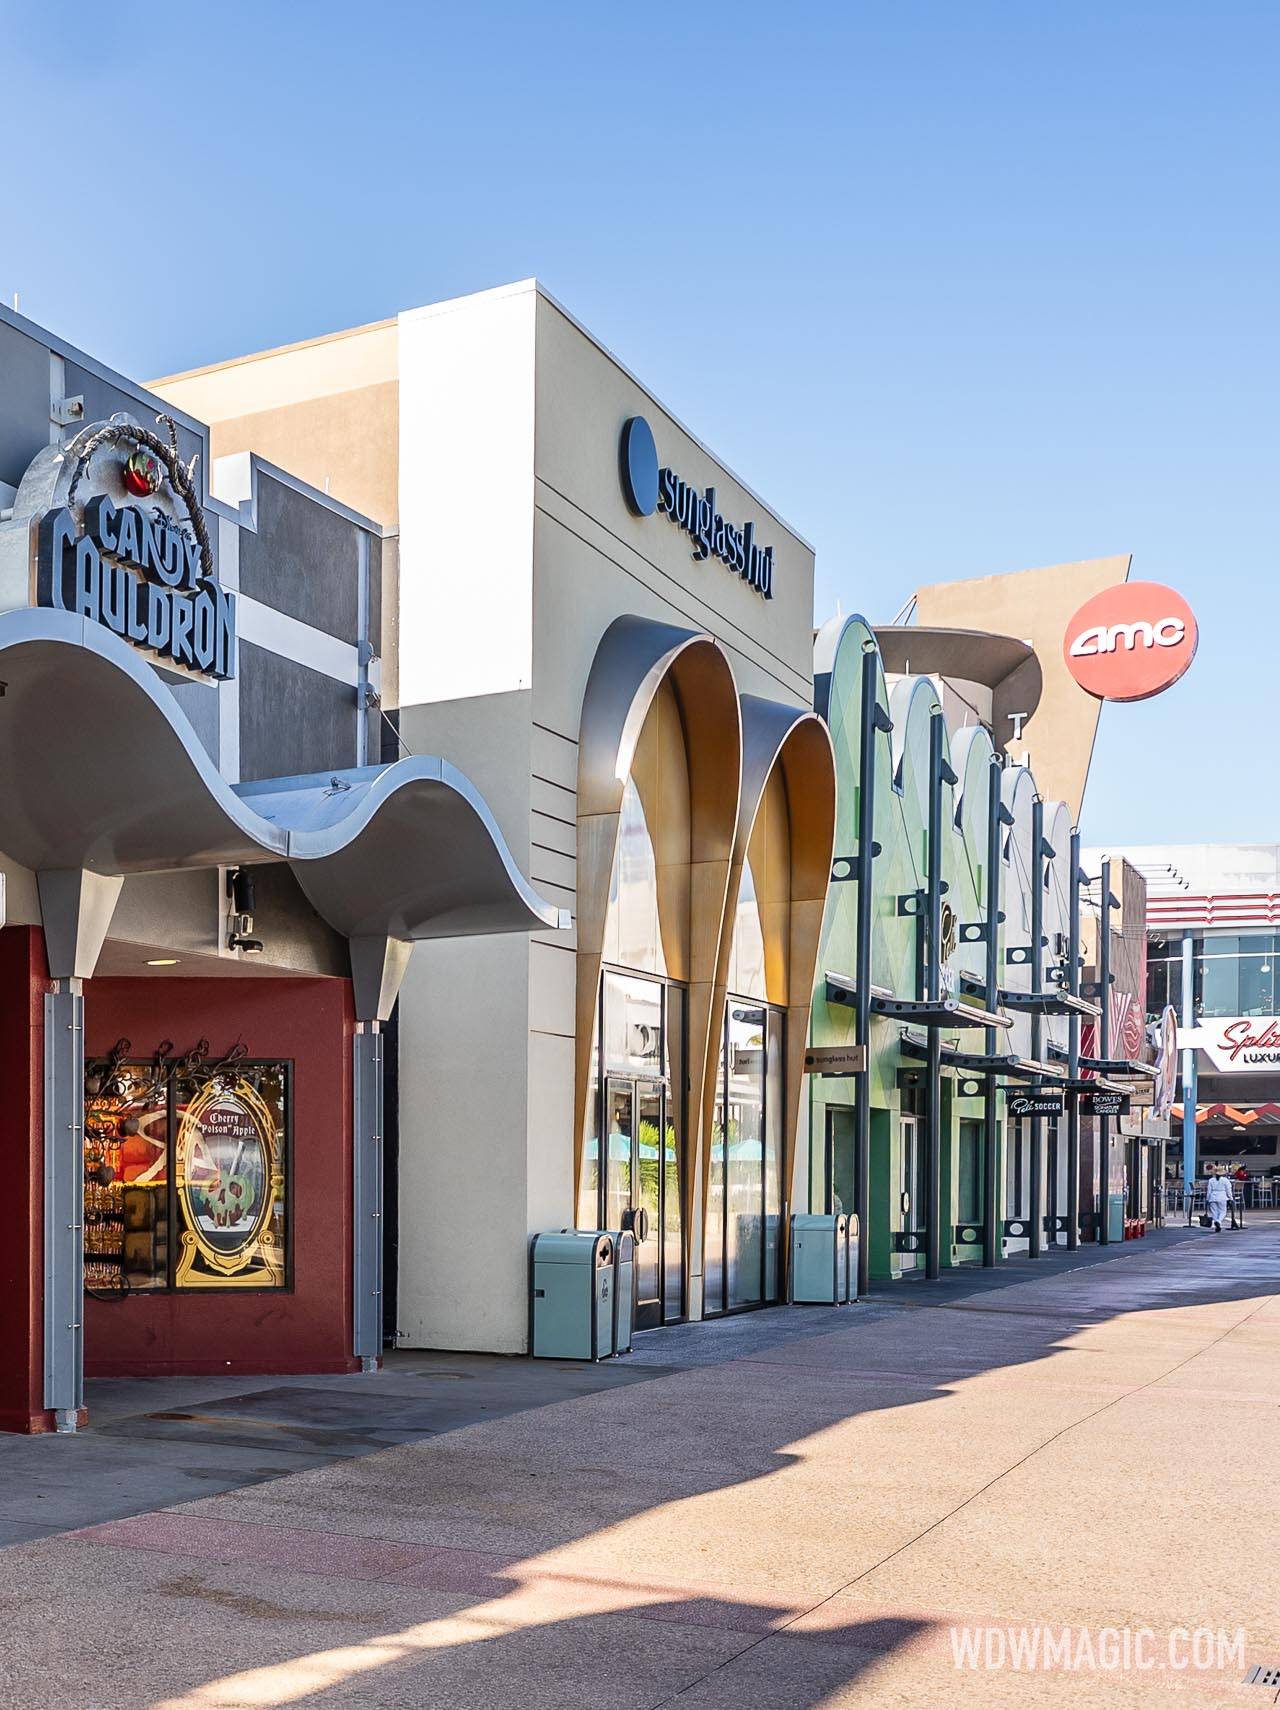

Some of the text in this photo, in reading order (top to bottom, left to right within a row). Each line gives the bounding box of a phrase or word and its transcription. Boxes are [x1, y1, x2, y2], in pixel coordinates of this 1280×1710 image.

[90, 496, 202, 589] CANDY
[657, 467, 774, 600] sunglass hut
[45, 507, 237, 680] CAULDRON
[1069, 617, 1185, 657] amc
[1034, 1102, 1061, 1111] SOCCER
[1092, 1096, 1122, 1104] BOWES
[209, 1112, 240, 1126] Cherry
[232, 1124, 256, 1137] Apple
